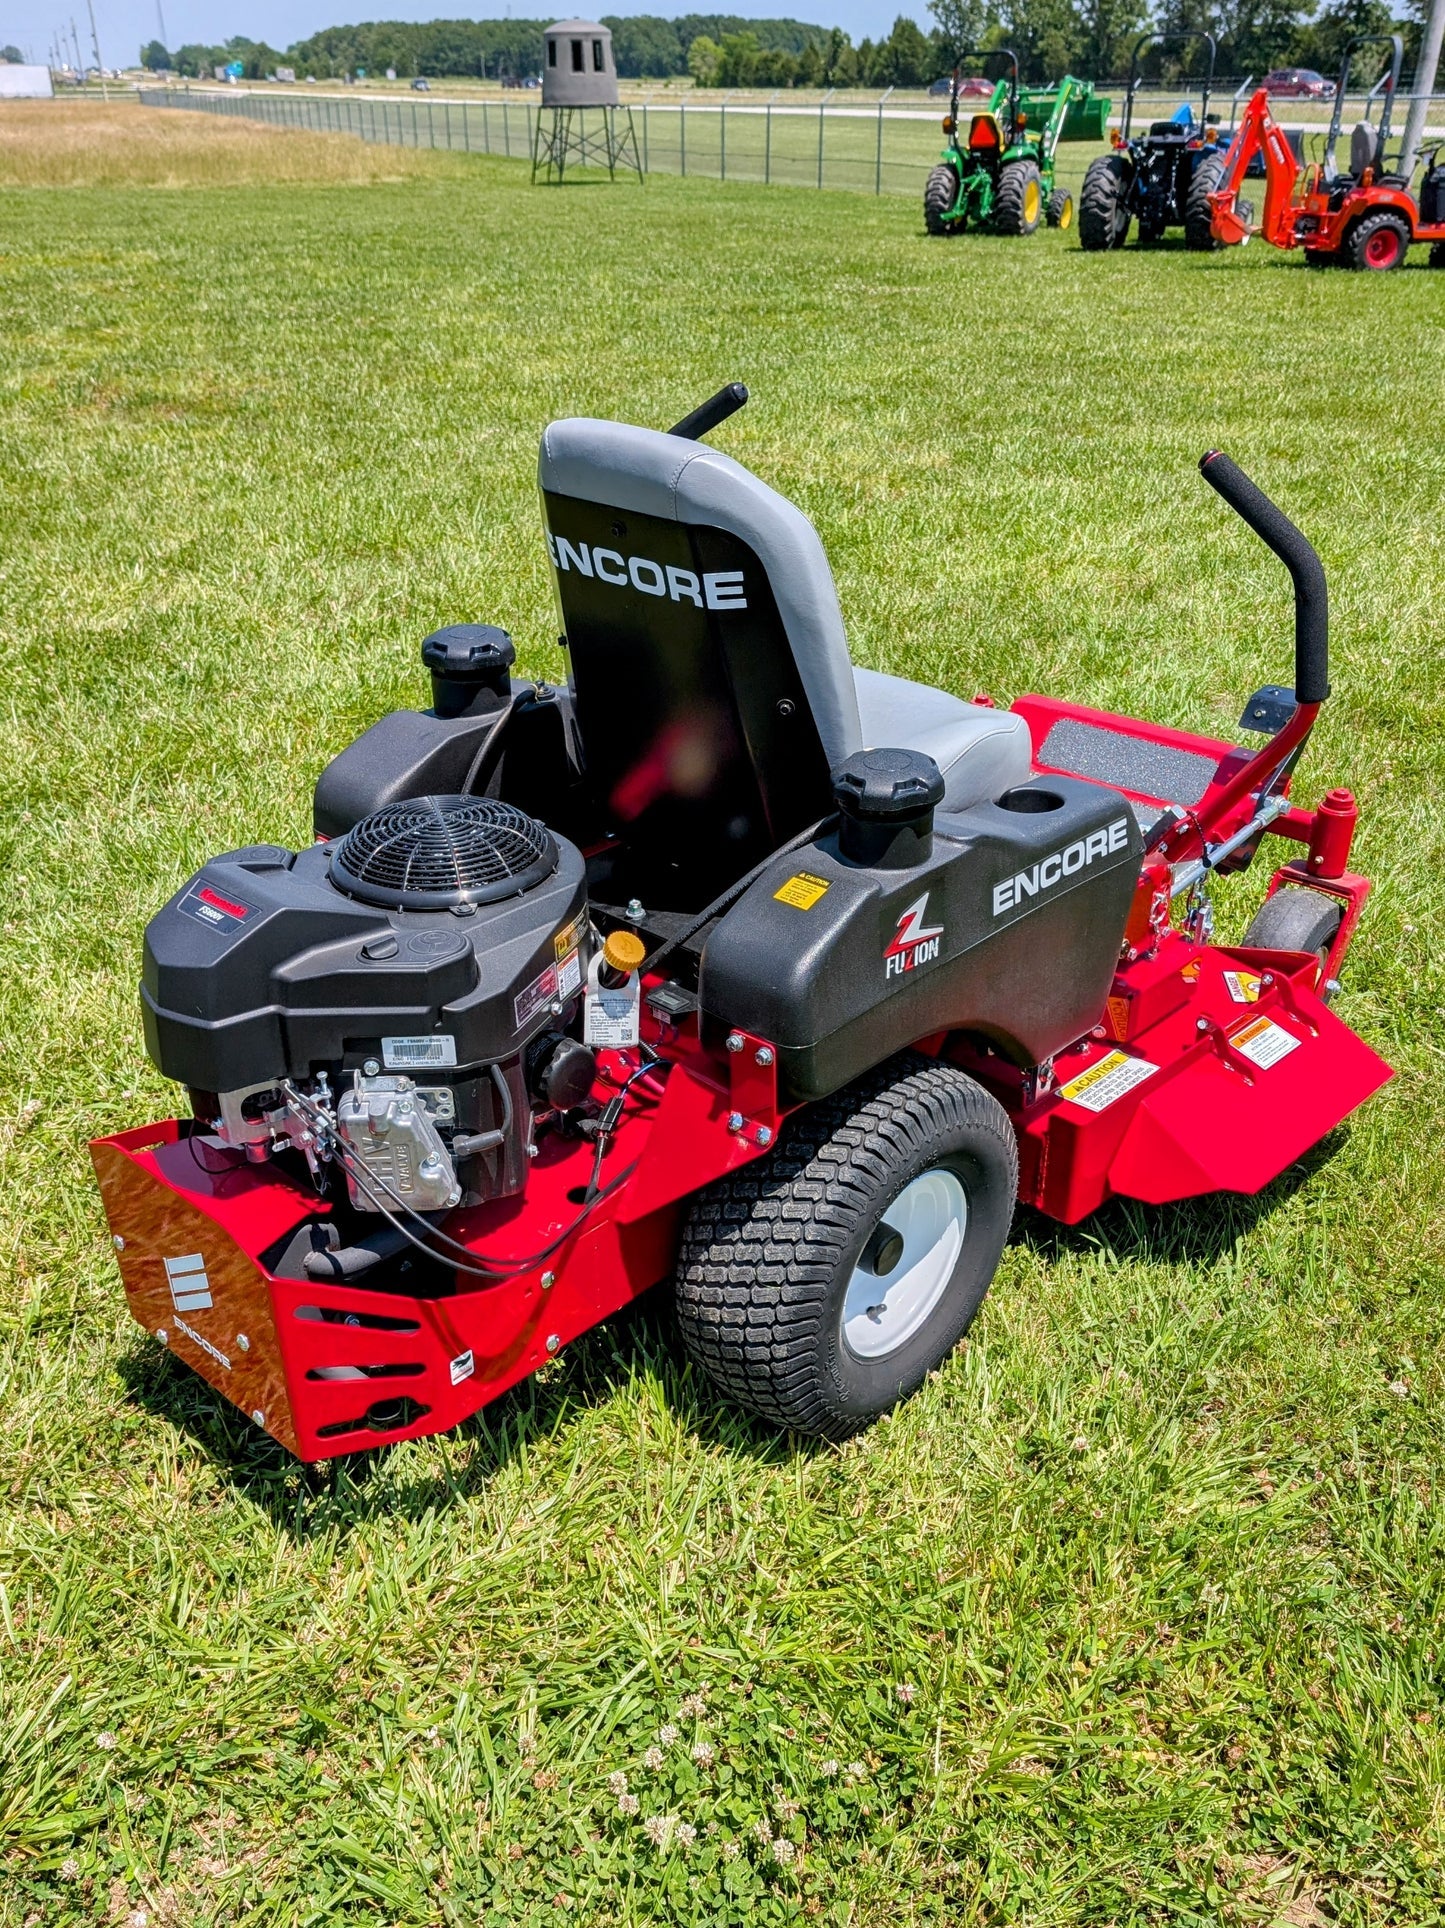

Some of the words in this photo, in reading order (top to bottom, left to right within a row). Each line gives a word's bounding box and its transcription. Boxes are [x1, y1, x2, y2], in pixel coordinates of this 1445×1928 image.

[805, 874, 830, 887] CAUTION
[992, 816, 1129, 917] ENCORE
[198, 886, 248, 919] Kawasaki
[886, 935, 940, 979] FUZION
[1227, 976, 1243, 997] DANGER
[1079, 1058, 1121, 1087] CAUTION
[173, 1314, 232, 1370] ENCORE
